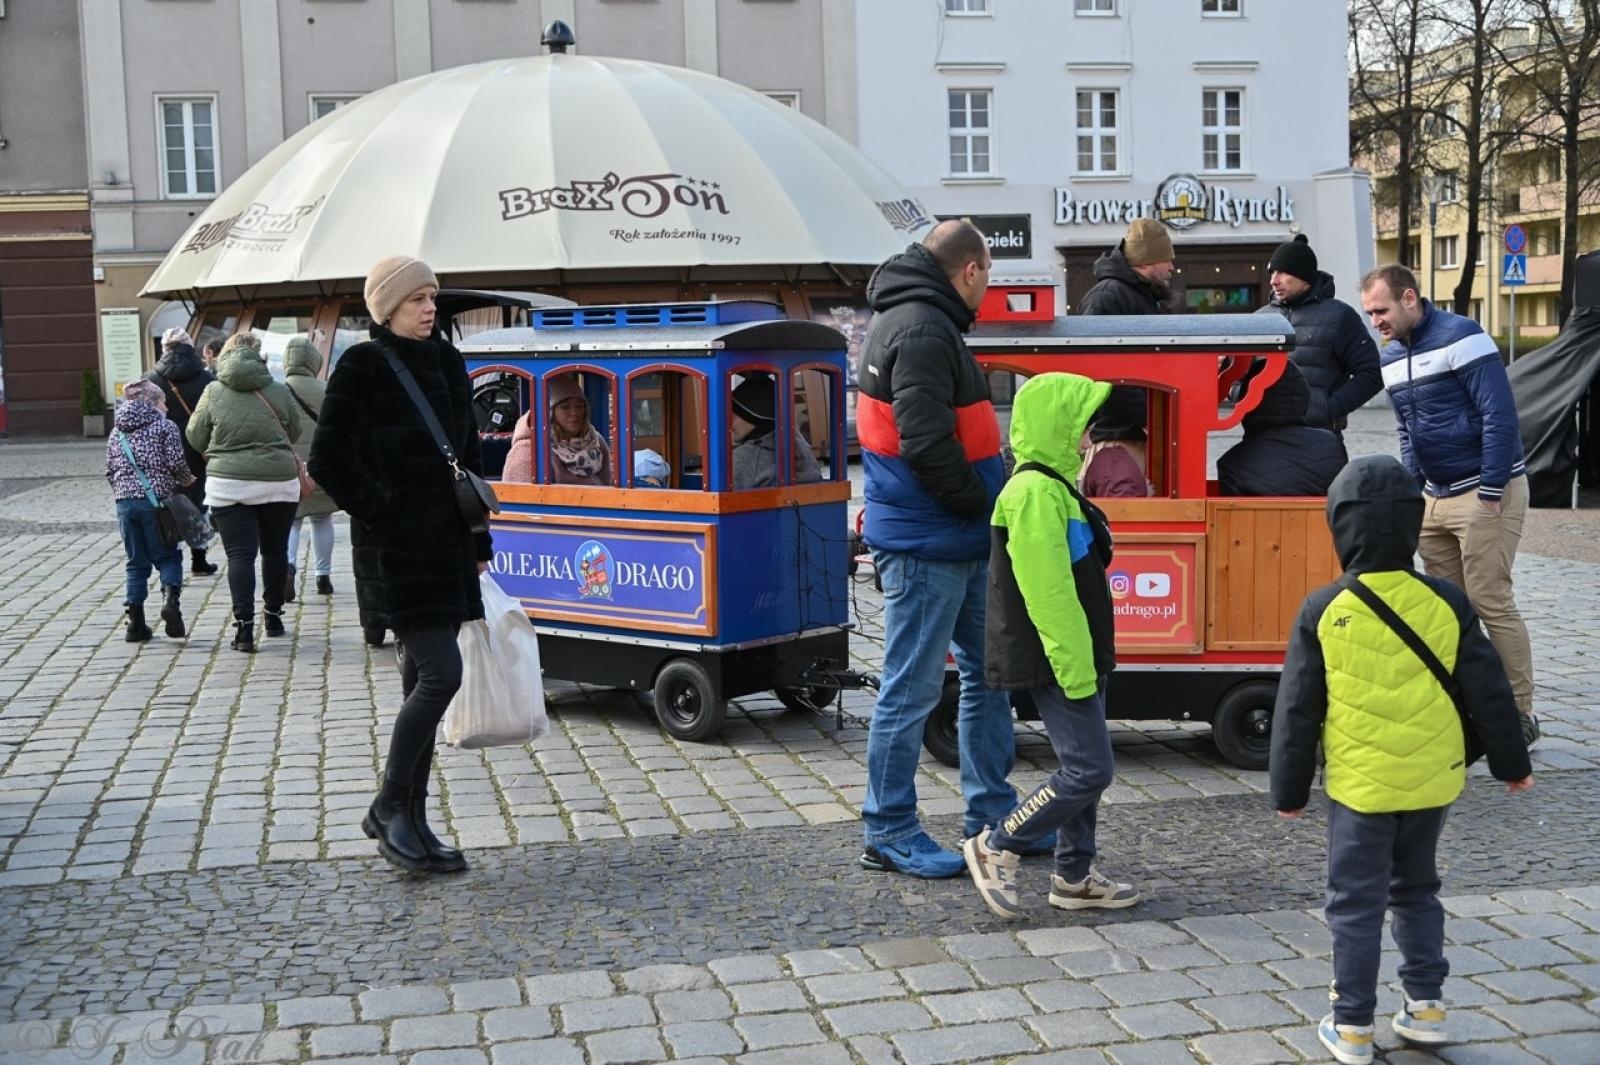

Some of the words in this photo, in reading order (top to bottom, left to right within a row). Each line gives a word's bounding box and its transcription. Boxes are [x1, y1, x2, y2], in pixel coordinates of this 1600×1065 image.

[1054, 187, 1152, 225] Browar
[1212, 185, 1296, 228] Rynek
[608, 228, 641, 243] Rok
[643, 228, 706, 240] założenia
[711, 232, 741, 246] 1997
[985, 230, 1024, 248] pieki
[616, 561, 695, 591] DRAGO
[1113, 602, 1176, 619] adrago.pl
